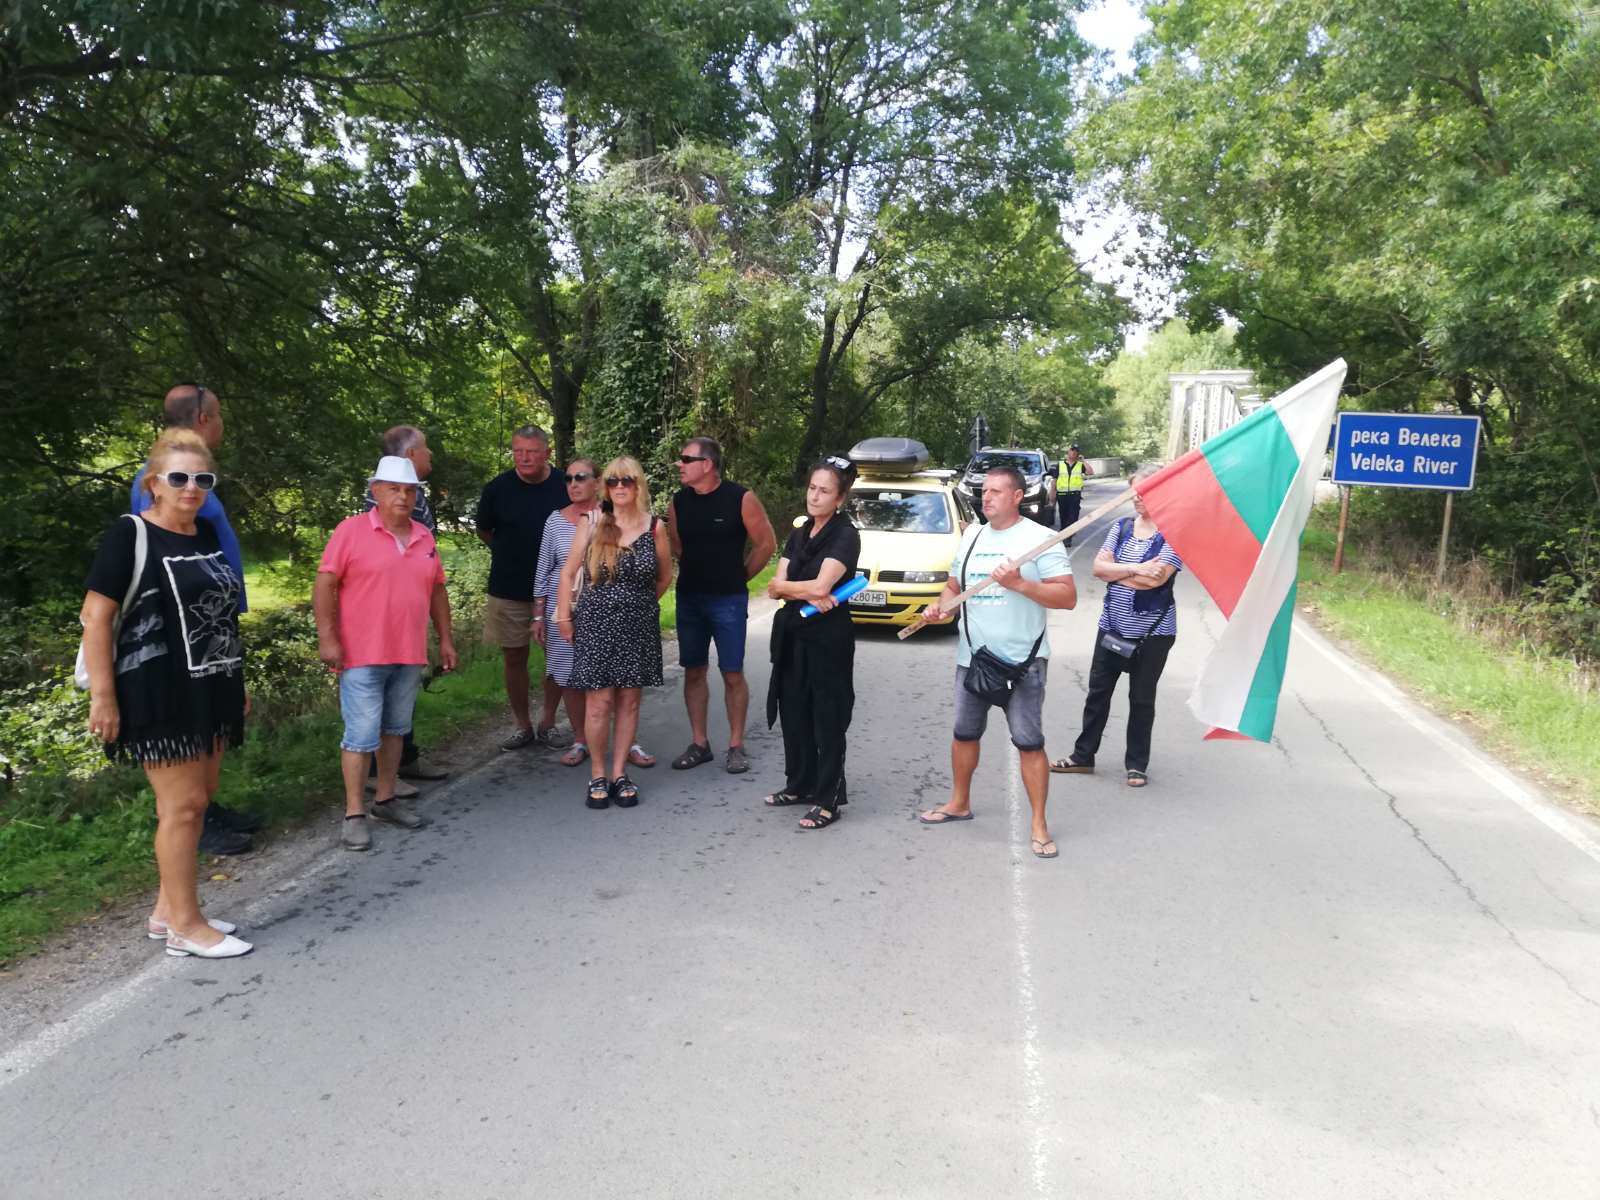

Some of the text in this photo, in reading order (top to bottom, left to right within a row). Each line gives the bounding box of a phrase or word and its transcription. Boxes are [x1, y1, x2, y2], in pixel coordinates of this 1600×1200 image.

[1351, 427, 1461, 448] река Велека
[1350, 452, 1458, 475] Veleka River
